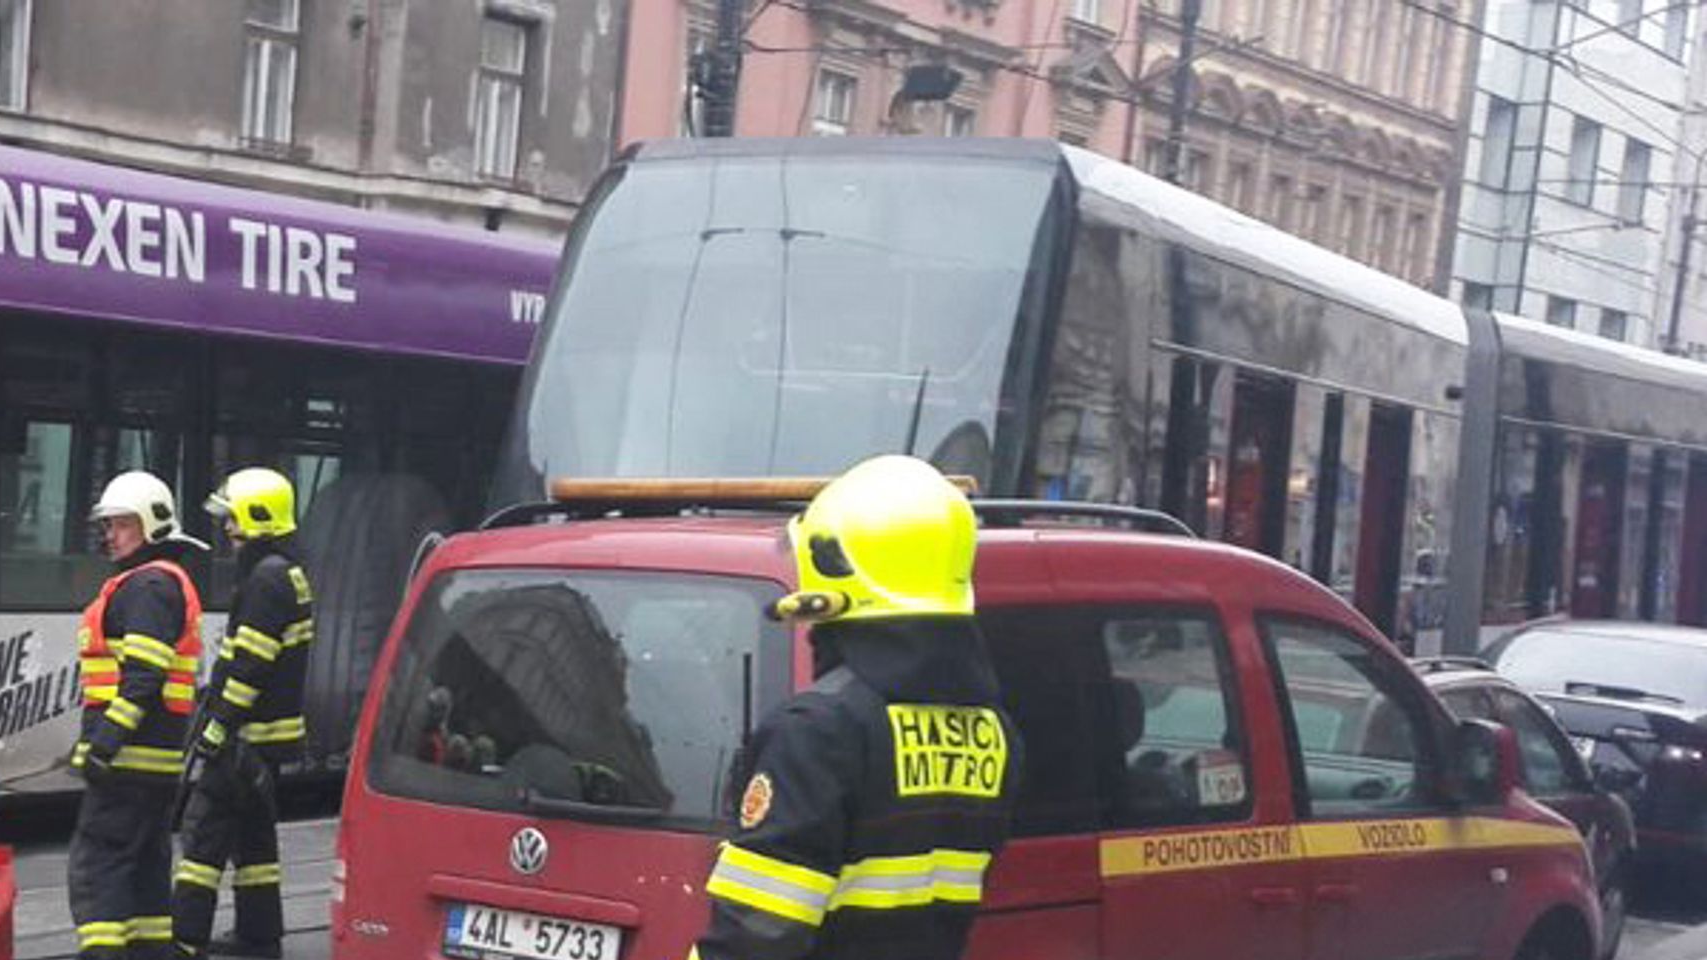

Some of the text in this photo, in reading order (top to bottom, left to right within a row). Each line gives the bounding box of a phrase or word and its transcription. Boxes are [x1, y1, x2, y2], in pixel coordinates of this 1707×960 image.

[229, 218, 356, 302] TIRE
[897, 712, 1000, 749] HASICI
[468, 909, 513, 948] 4AL
